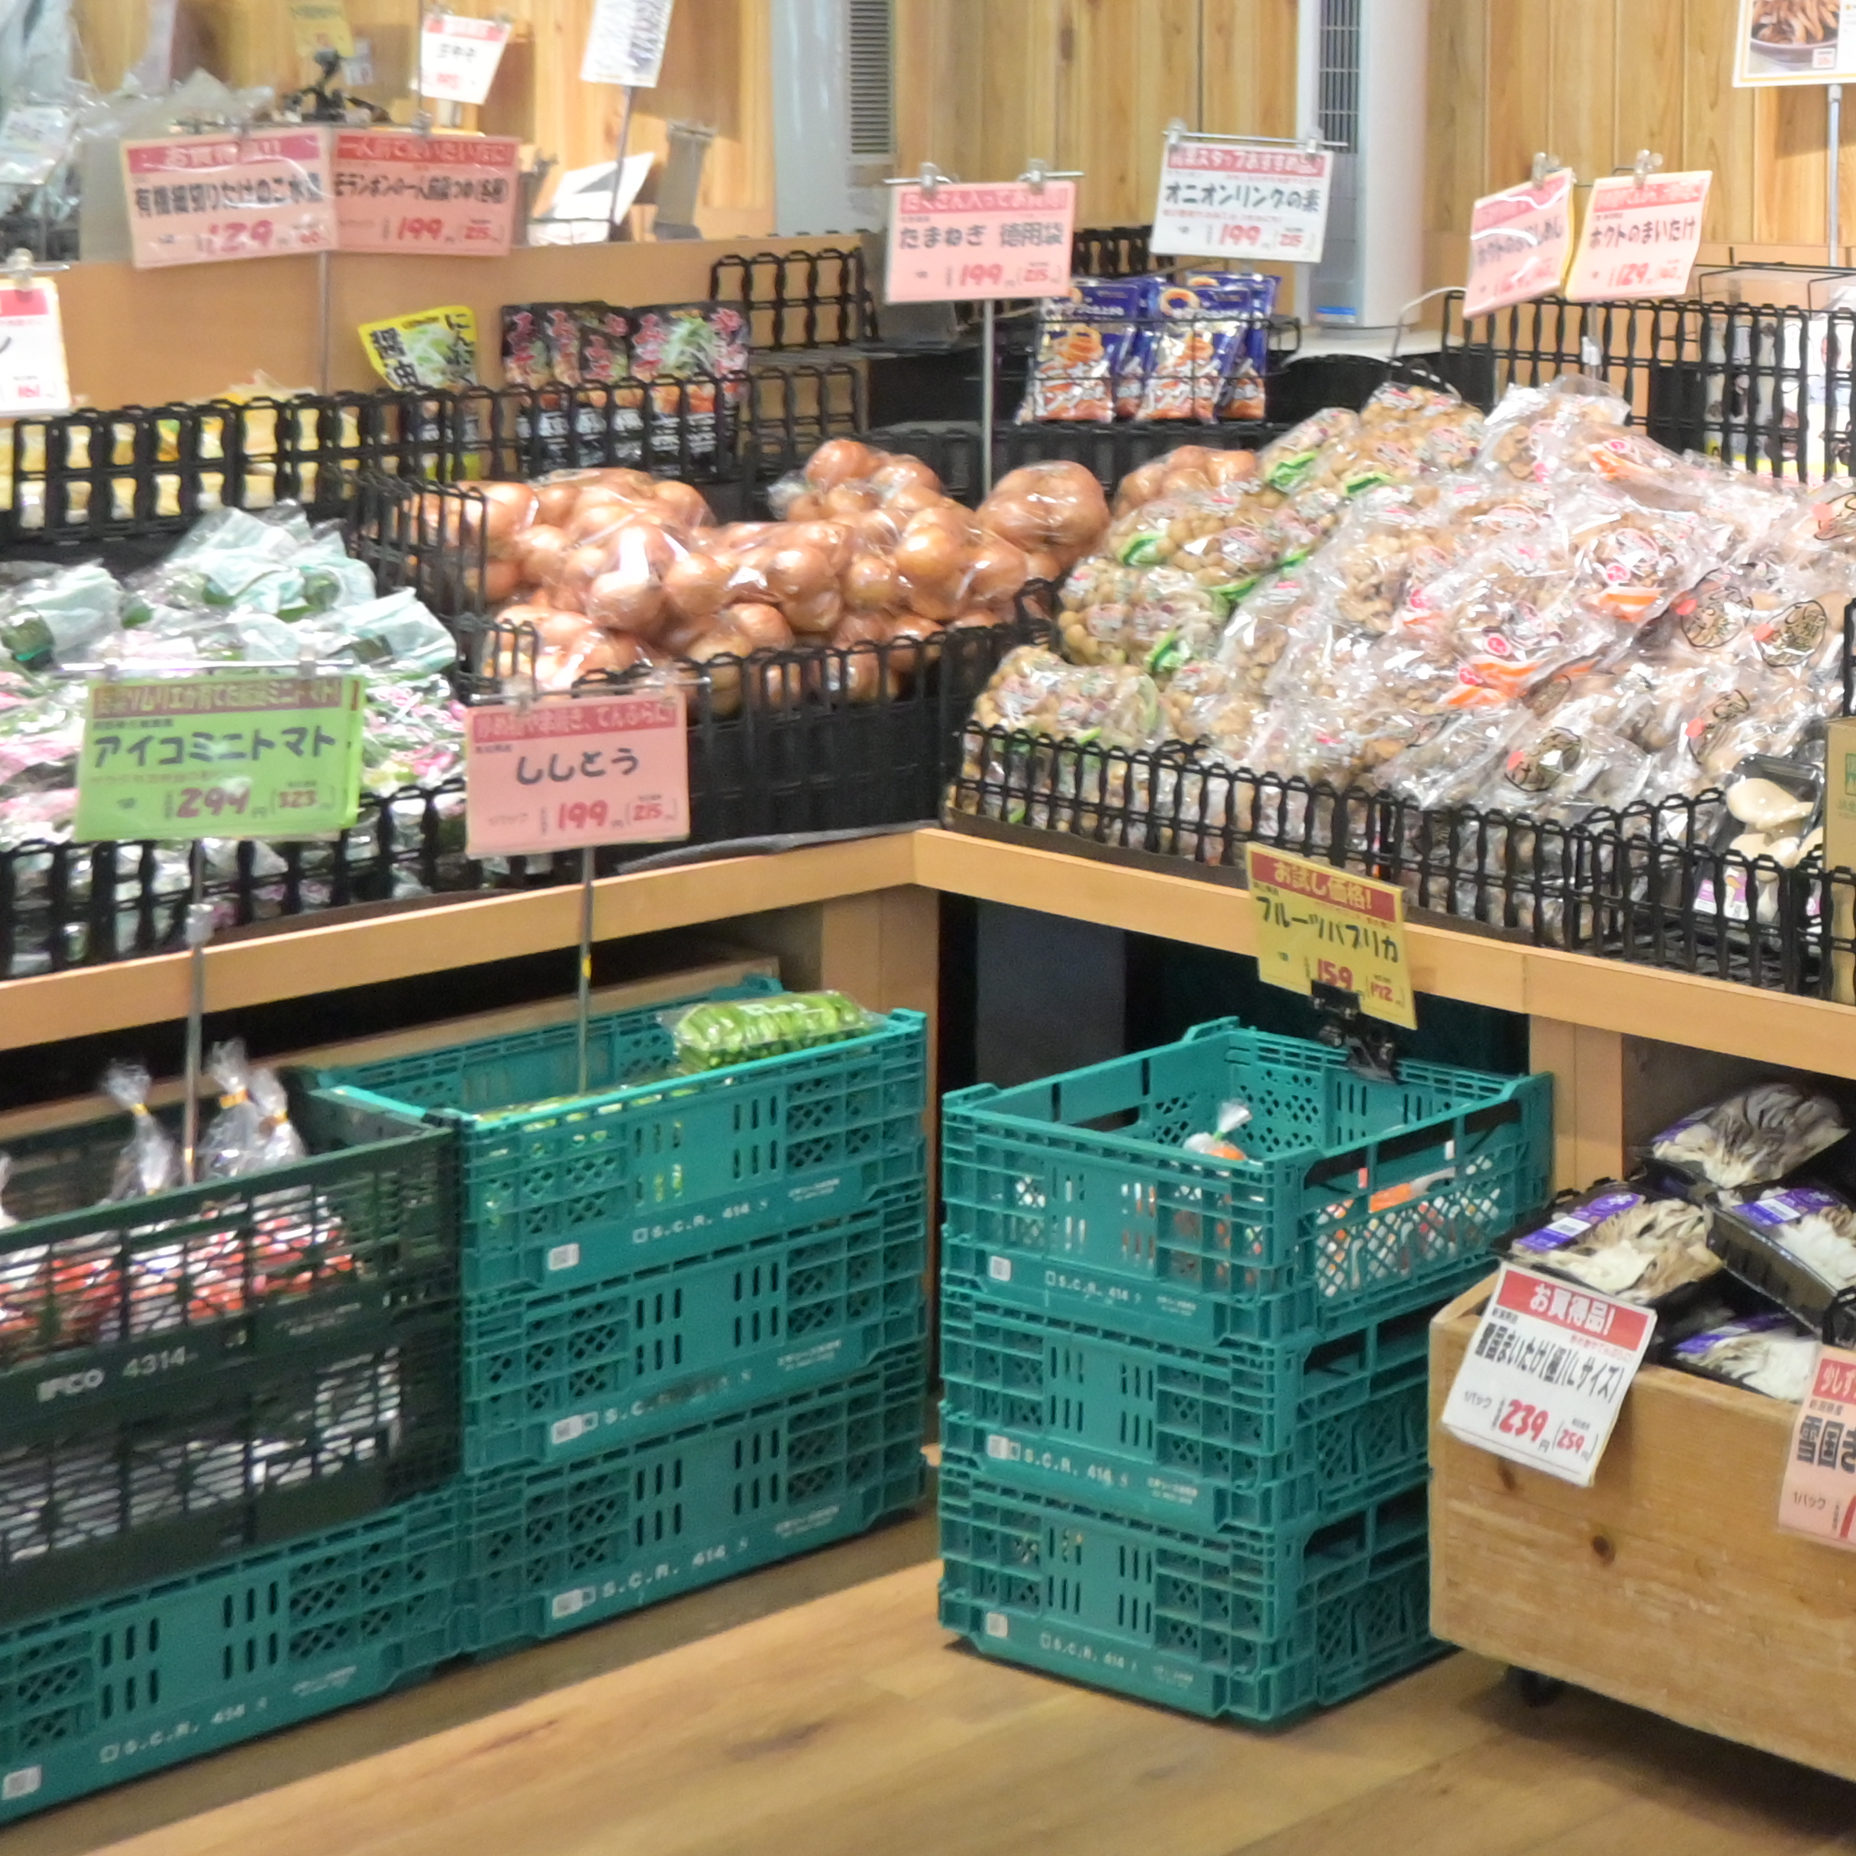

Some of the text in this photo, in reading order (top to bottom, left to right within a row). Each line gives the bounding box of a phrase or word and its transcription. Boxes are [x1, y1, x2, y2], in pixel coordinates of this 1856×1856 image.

[1165, 182, 1321, 212] オニオンリングの素
[399, 217, 446, 241] 199
[900, 224, 986, 249] たまねぎ
[1220, 224, 1262, 245] 199
[1589, 216, 1696, 250] ホクトのまいたけ
[960, 263, 1003, 286] 199
[1617, 262, 1649, 287] 129
[94, 724, 338, 769] アイコミニトマト
[516, 747, 641, 786] ししとう
[558, 799, 608, 829] 199
[1272, 860, 1373, 911] お試し価格!
[1318, 958, 1354, 991] 159
[1529, 1282, 1616, 1337] お買得品!
[1499, 1398, 1550, 1443] 239
[1556, 1427, 1586, 1455] 259
[1793, 1491, 1827, 1511] 1パック
